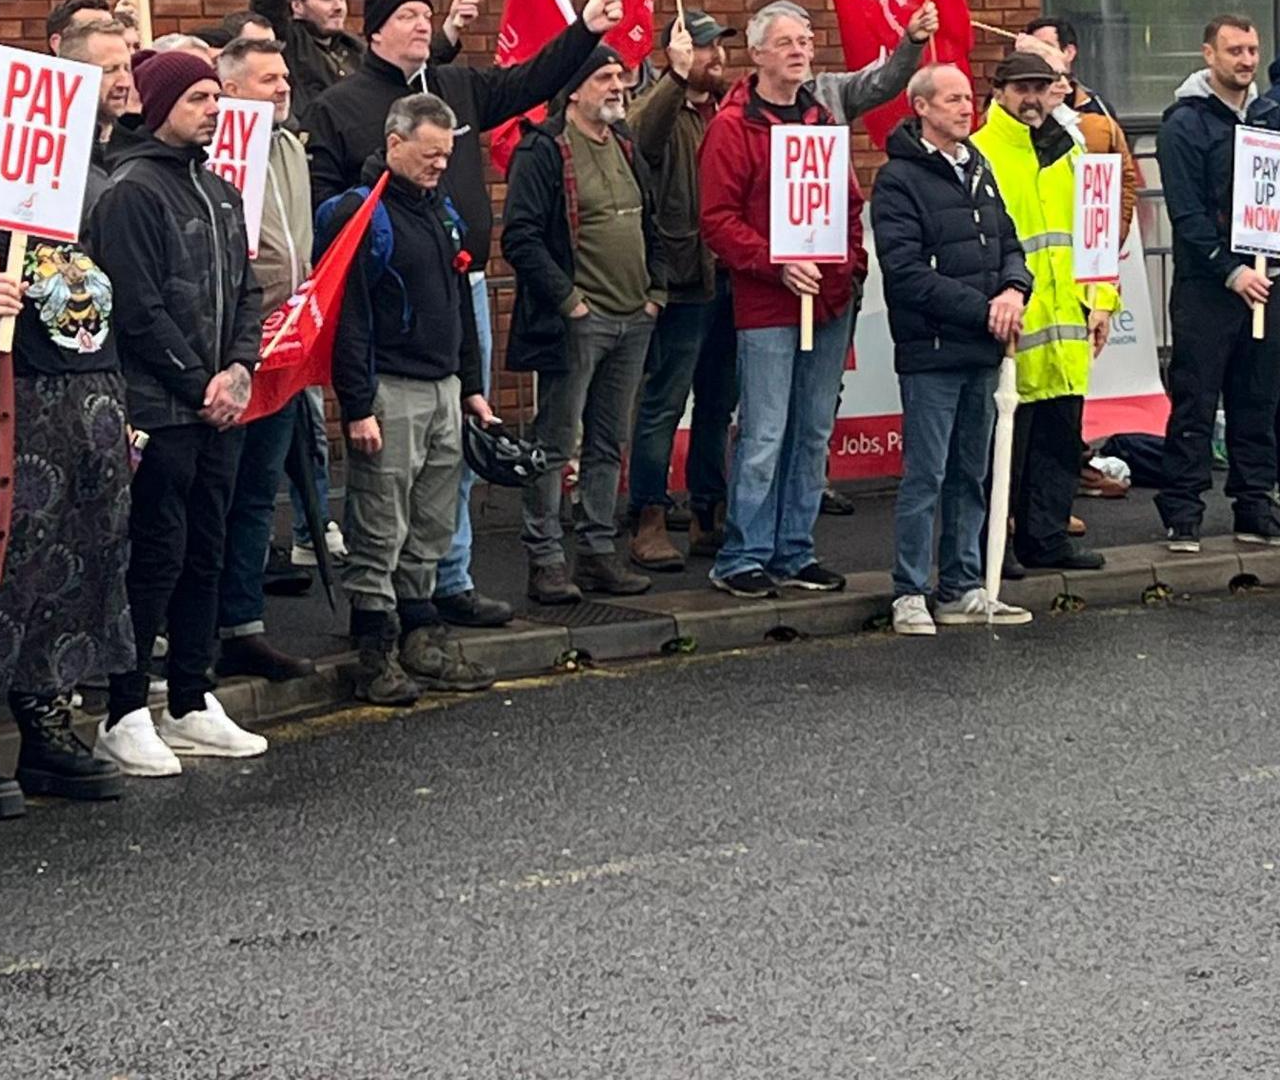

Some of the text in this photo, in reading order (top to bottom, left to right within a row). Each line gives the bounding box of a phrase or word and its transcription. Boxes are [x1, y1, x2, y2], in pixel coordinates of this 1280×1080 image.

[3, 61, 83, 129] PAY
[214, 109, 259, 160] AY
[0, 123, 67, 190] UP!
[785, 134, 836, 179] PAY
[1252, 156, 1280, 182] PAY
[788, 182, 830, 226] UP!
[1082, 163, 1113, 205] PAY
[1254, 181, 1276, 206] UP
[1083, 206, 1110, 249] UP!
[837, 433, 884, 456] Jobs,
